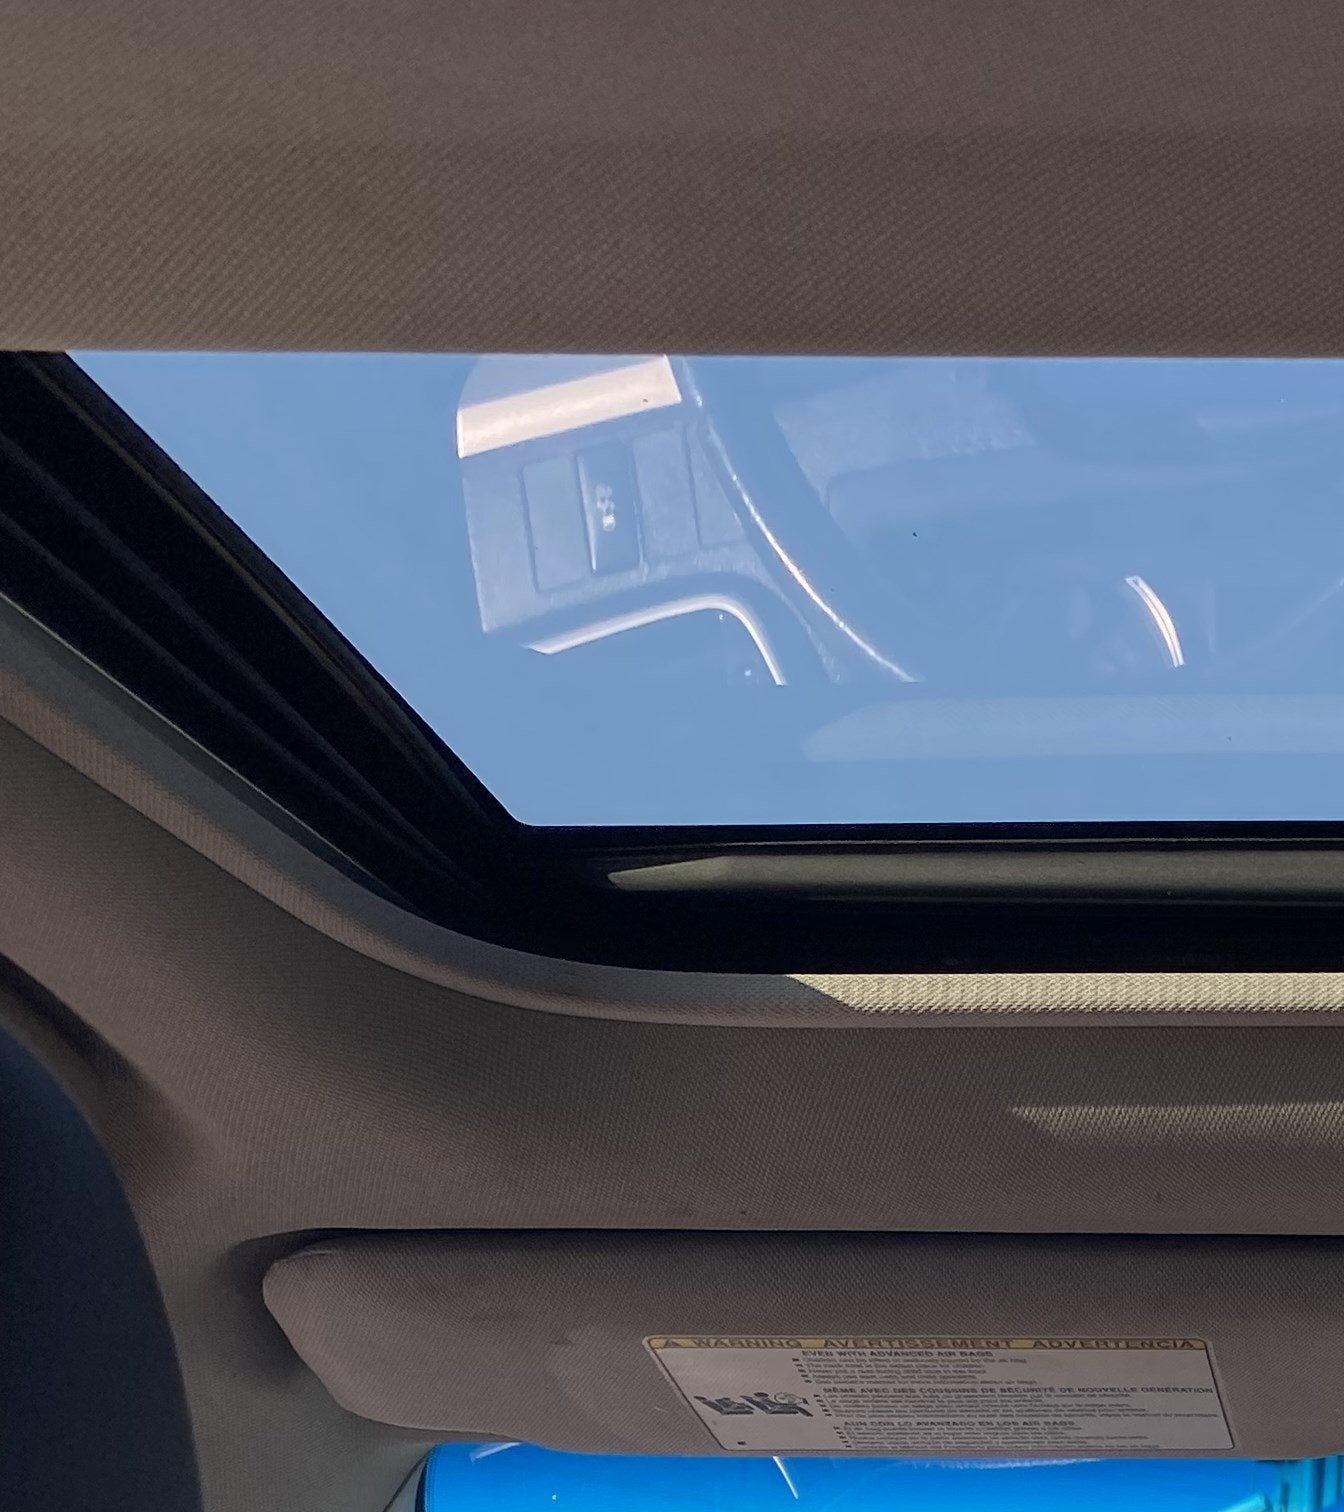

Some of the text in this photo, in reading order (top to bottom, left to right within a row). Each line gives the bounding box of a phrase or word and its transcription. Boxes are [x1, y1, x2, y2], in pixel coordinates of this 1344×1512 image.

[692, 1339, 1194, 1350] WARNING AVERTISSEMENT ADVERTENCIA
